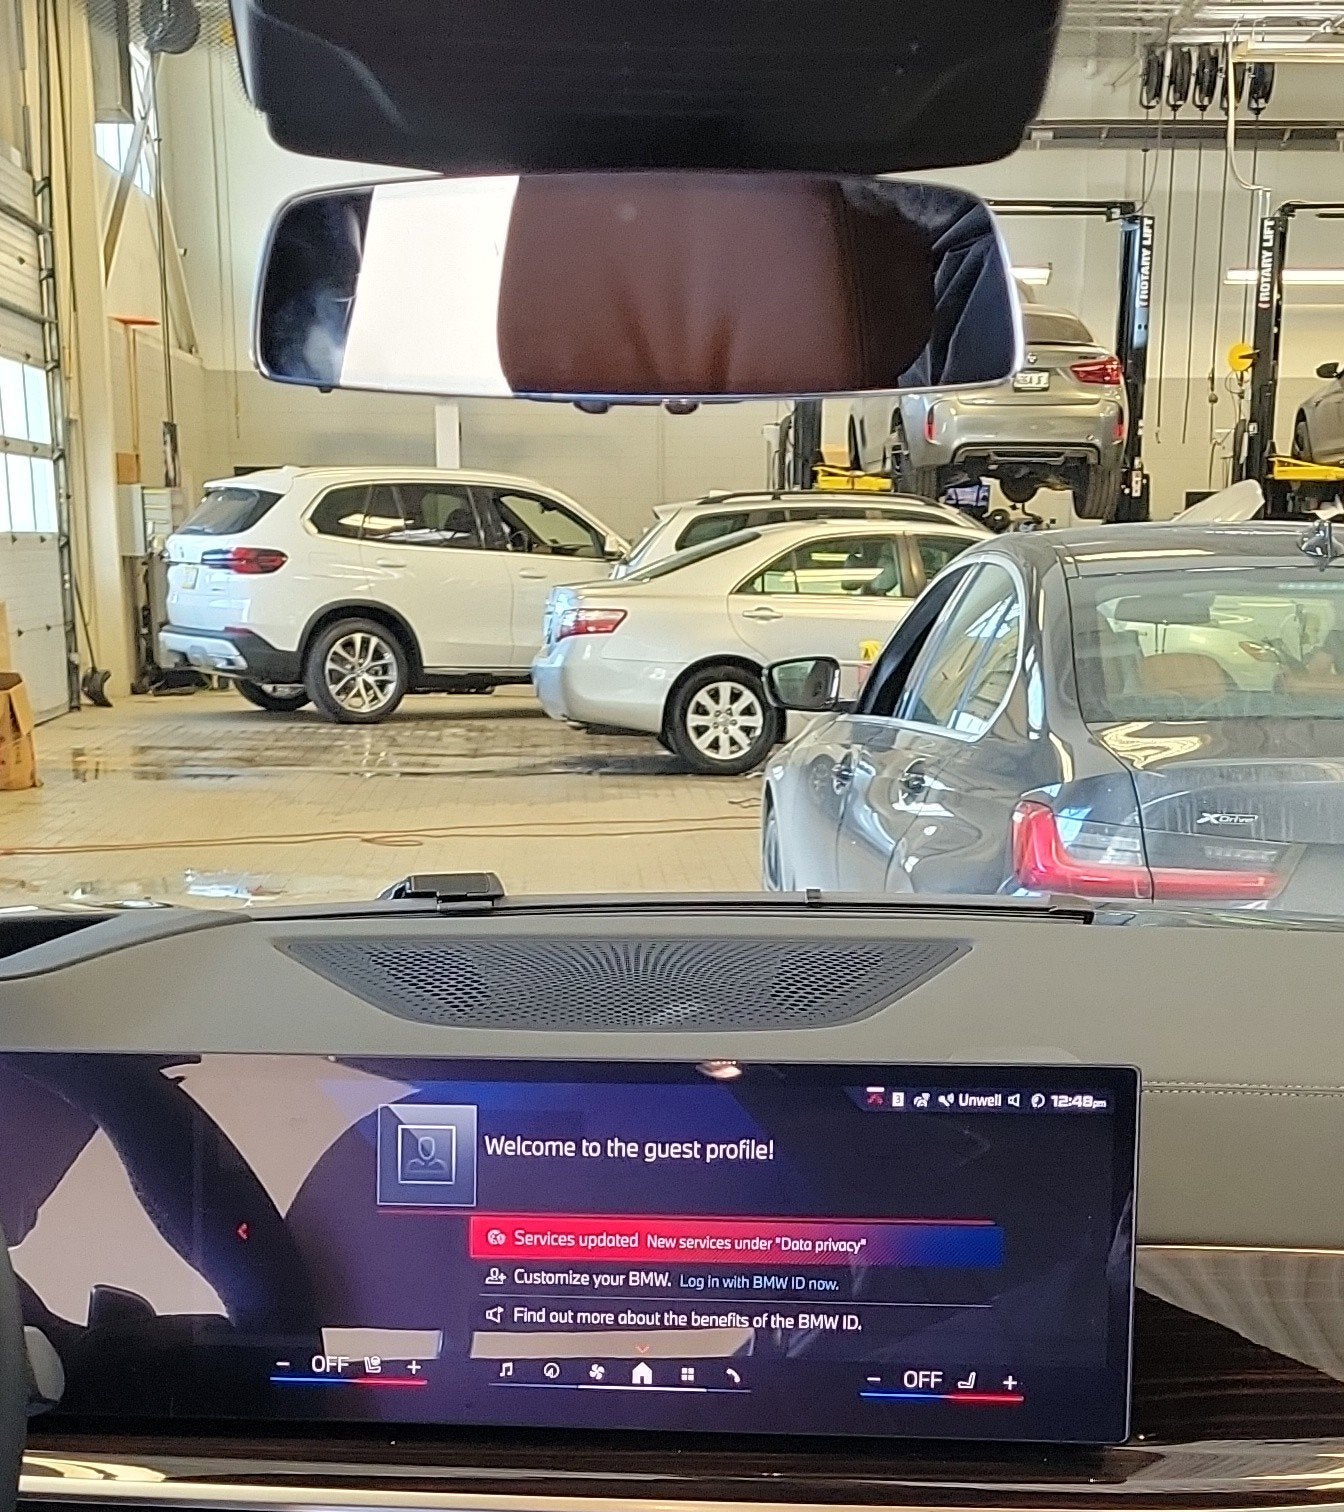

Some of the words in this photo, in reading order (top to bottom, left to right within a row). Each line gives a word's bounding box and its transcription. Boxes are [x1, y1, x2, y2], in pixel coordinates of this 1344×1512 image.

[1142, 217, 1153, 245] LIFT
[1262, 218, 1275, 247] LIFT
[1139, 248, 1152, 300] ROTARY
[1259, 250, 1273, 301] ROTARY
[958, 1093, 1002, 1107] Unwell
[484, 1135, 575, 1157] Welcome
[581, 1139, 601, 1157] to
[606, 1138, 638, 1158] the
[644, 1140, 701, 1162] guest
[706, 1139, 774, 1163] profile!
[514, 1230, 575, 1247] Services
[579, 1232, 639, 1251] updated
[647, 1235, 676, 1249] New
[679, 1237, 731, 1250] services
[735, 1237, 772, 1251] under
[775, 1237, 812, 1252] "Data
[815, 1237, 867, 1255] privacy"
[514, 1269, 589, 1287] Customize
[593, 1274, 625, 1291] your
[629, 1271, 672, 1287] BMW.
[680, 1275, 704, 1291] Log
[707, 1276, 719, 1289] in
[721, 1276, 749, 1290] with
[753, 1276, 789, 1290] BMW
[791, 1277, 806, 1290] ID
[809, 1279, 840, 1291] now.
[514, 1308, 546, 1323] Find
[549, 1310, 574, 1324] out
[577, 1312, 615, 1325] more
[617, 1310, 660, 1326] about
[663, 1311, 688, 1326] the
[691, 1311, 749, 1328] benefits
[753, 1313, 769, 1328] of
[770, 1313, 795, 1329] the
[798, 1314, 840, 1329] BMW
[311, 1355, 350, 1373] OFF
[904, 1370, 943, 1388] OFF
